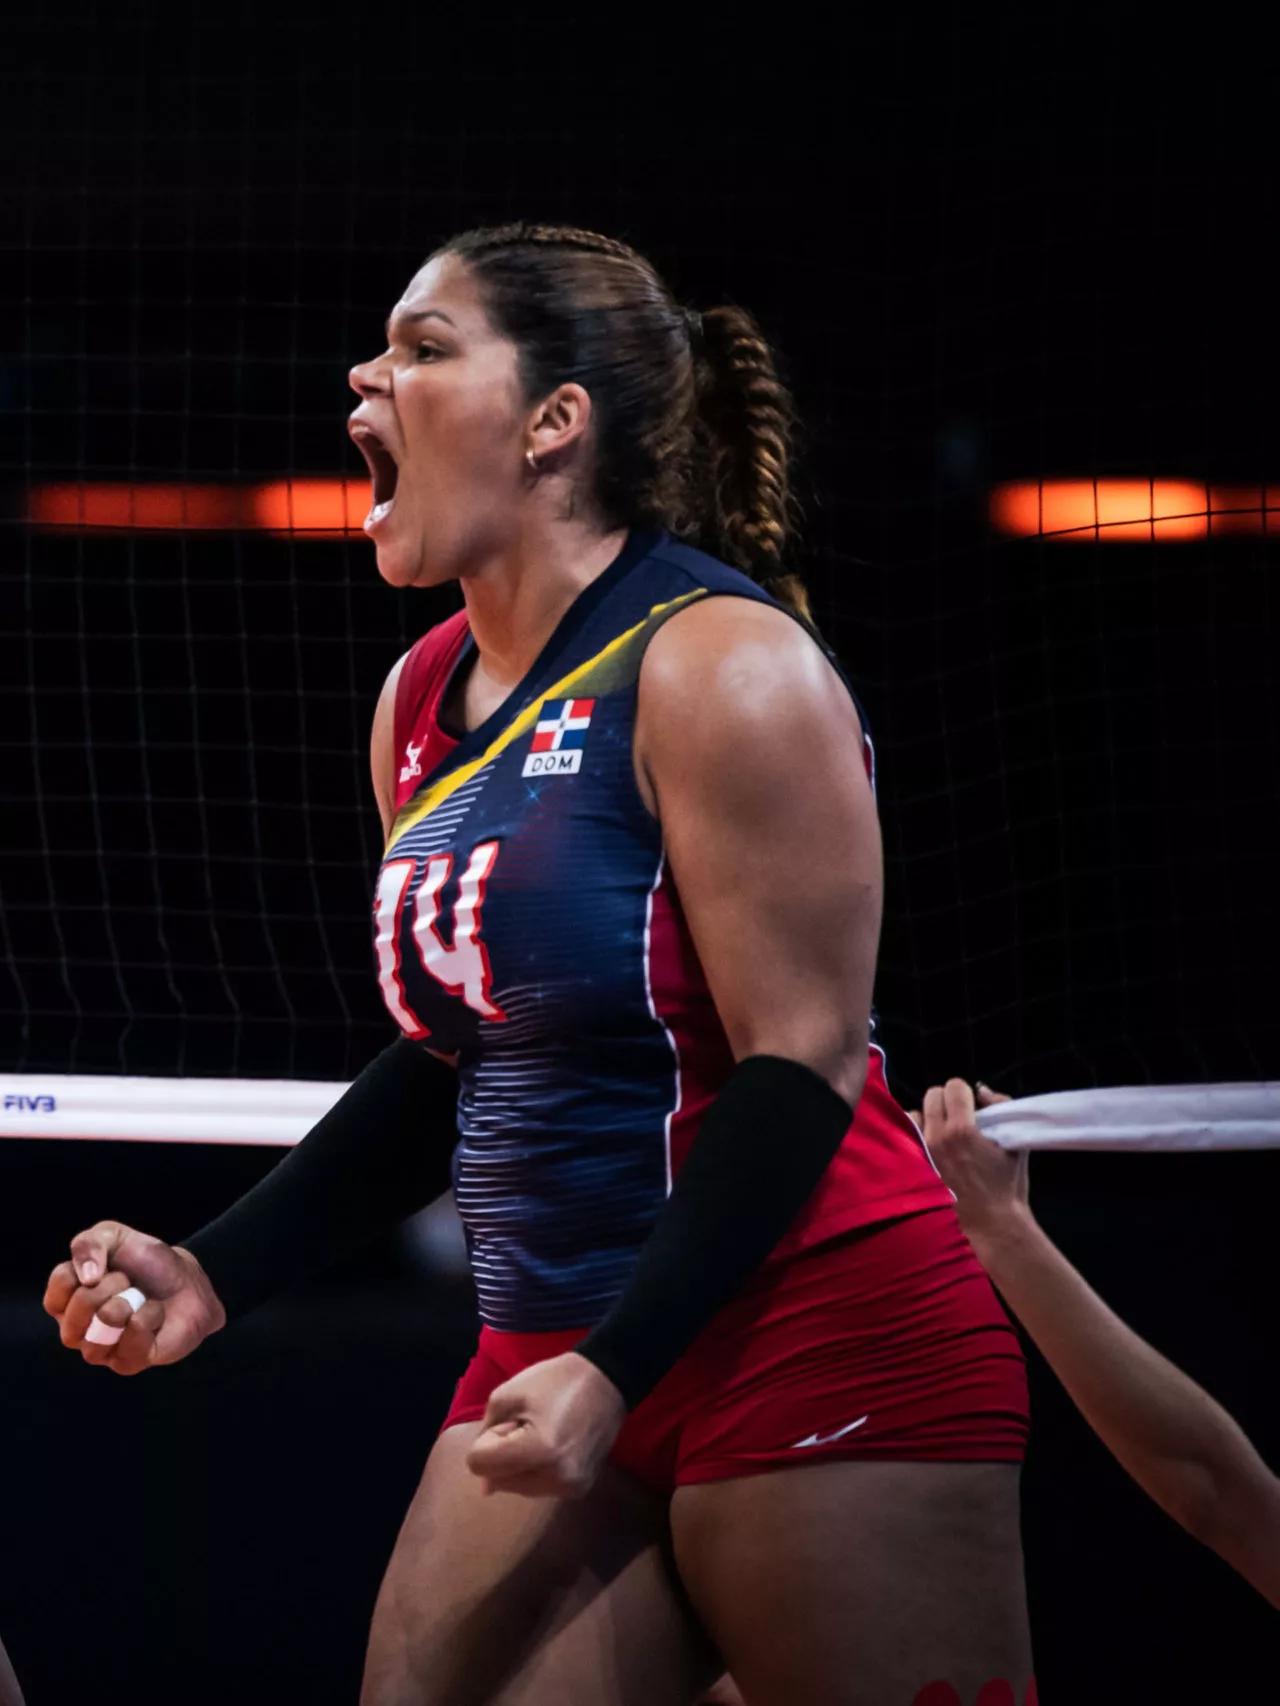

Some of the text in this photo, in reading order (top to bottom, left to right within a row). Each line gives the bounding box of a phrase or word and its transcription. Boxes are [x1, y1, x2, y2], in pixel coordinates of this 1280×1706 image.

[531, 754, 575, 773] DOM
[373, 841, 508, 1040] 14
[3, 1095, 57, 1112] FIVB
